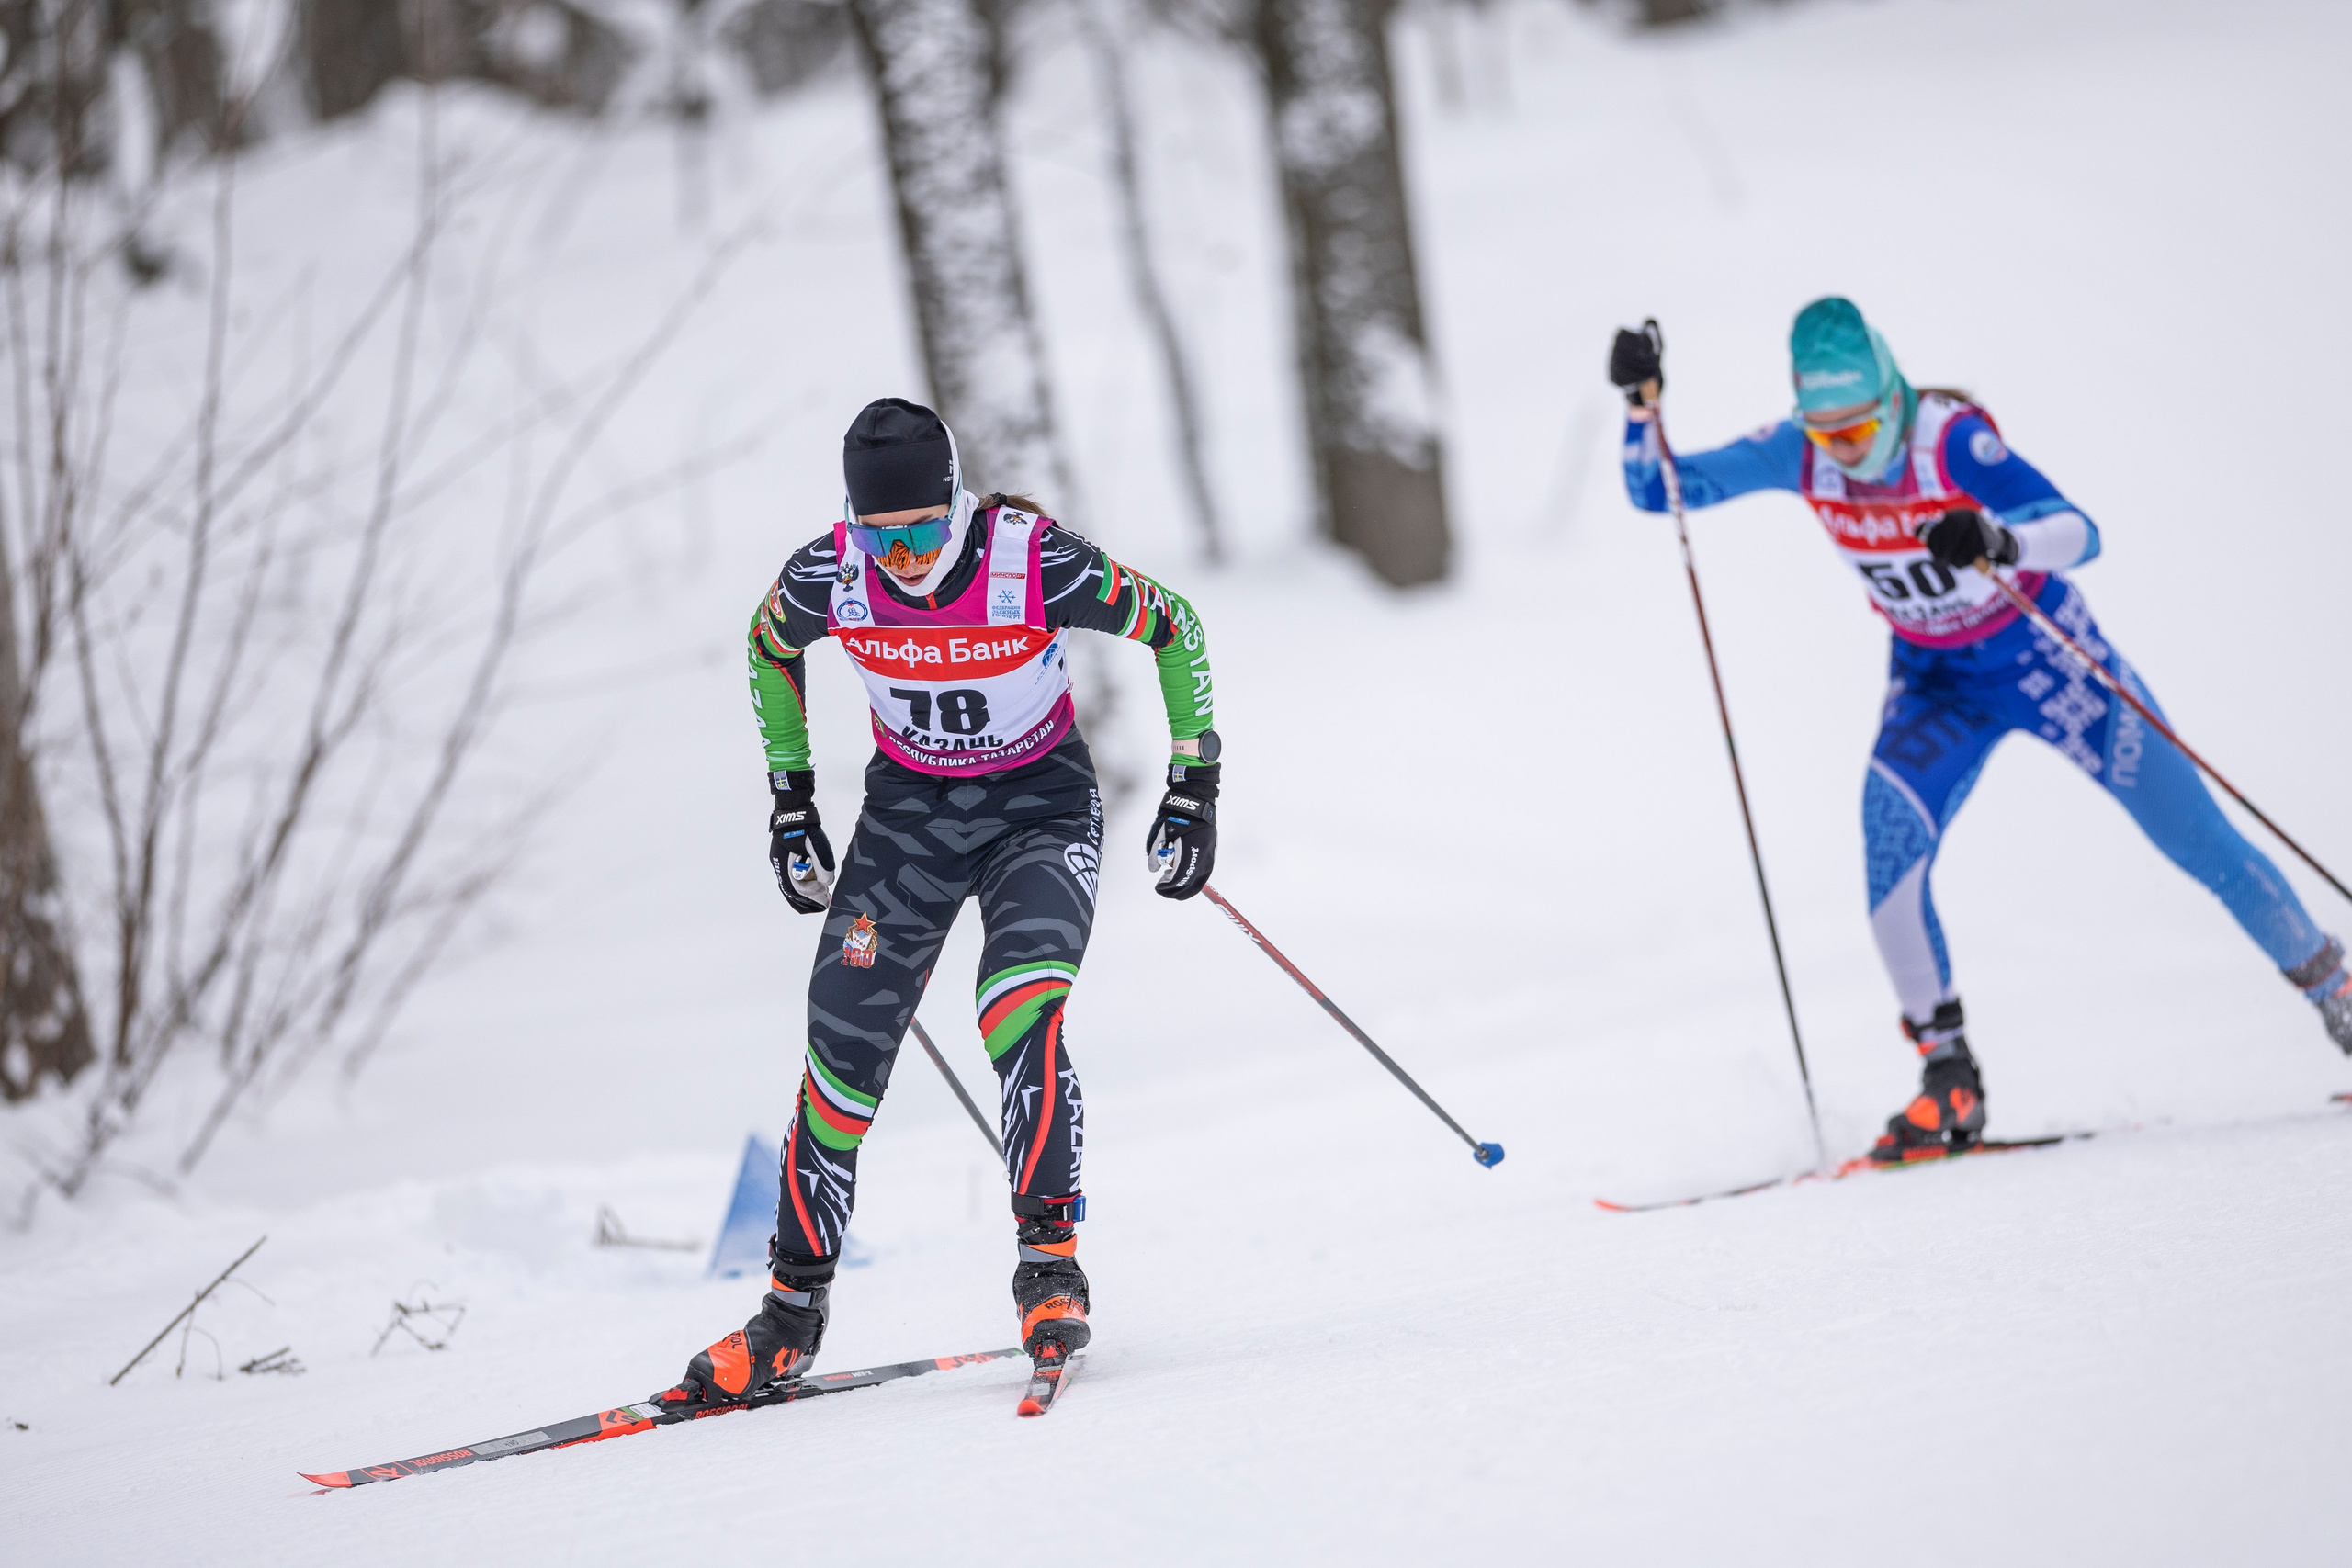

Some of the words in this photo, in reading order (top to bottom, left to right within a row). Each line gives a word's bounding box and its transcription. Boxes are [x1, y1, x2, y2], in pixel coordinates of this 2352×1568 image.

[948, 636, 1030, 663] Банк
[889, 687, 990, 736] 78
[841, 946, 873, 968] 100
[407, 1448, 474, 1467] ROSSIGNOL
